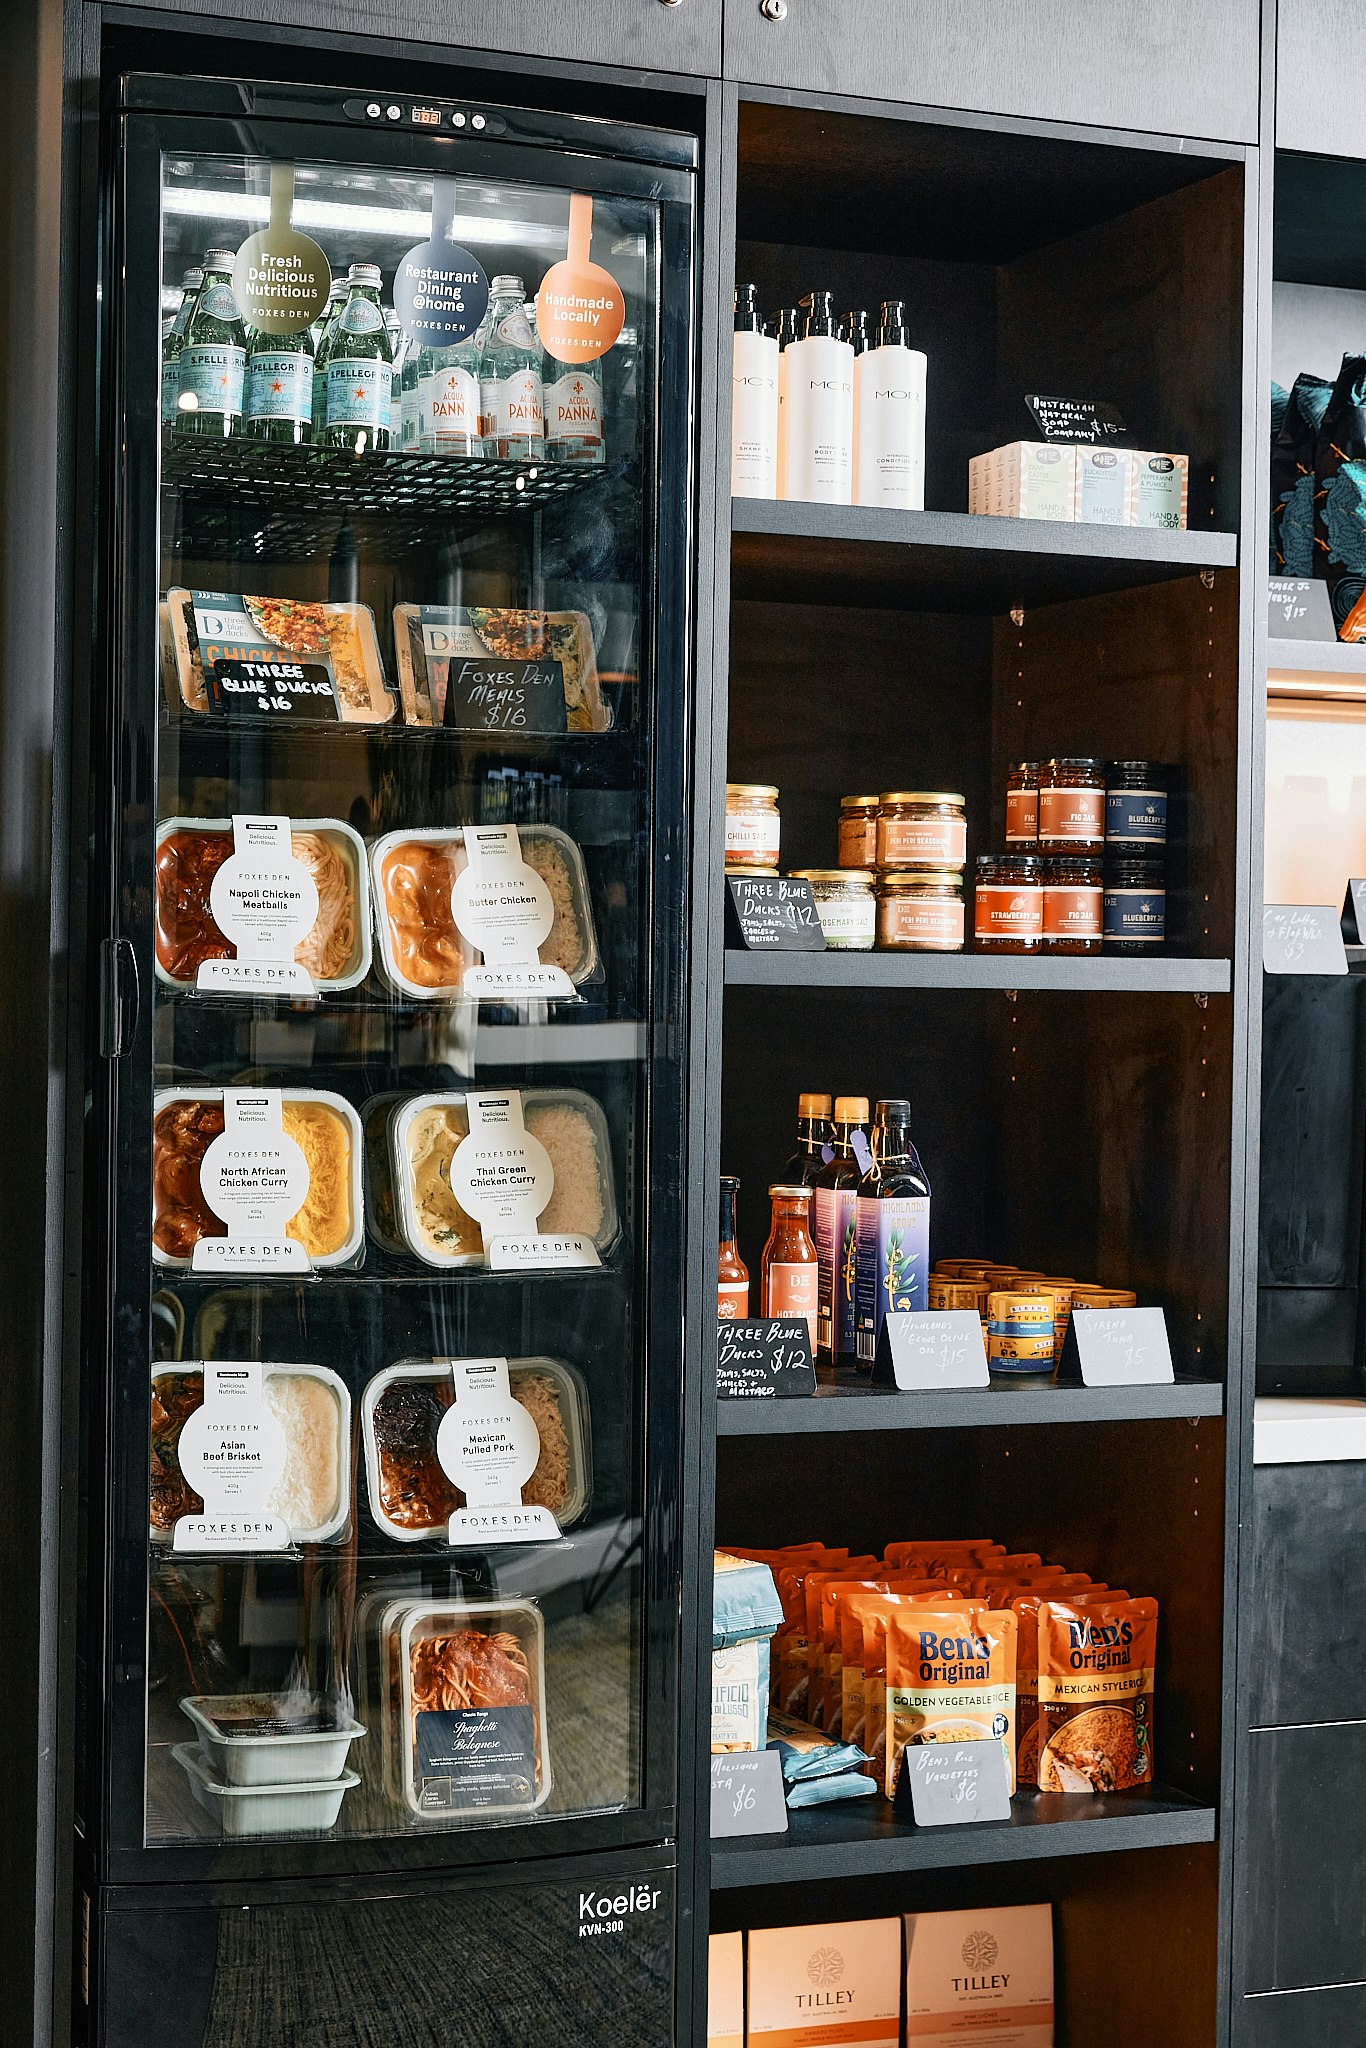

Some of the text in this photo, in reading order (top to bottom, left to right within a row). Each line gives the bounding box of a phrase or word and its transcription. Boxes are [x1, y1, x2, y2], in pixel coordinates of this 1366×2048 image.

[261, 253, 302, 268] Fresh
[248, 267, 315, 283] Delicious
[405, 264, 478, 284] Restaurant
[245, 282, 318, 298] Nutritious
[418, 280, 462, 300] Dining
[412, 295, 465, 312] @home
[545, 292, 614, 310] Handmade
[252, 308, 285, 318] FOXES
[554, 307, 600, 327] Locally
[410, 320, 466, 332] FOXES DEN
[550, 337, 602, 348] FOXES DEN
[444, 392, 464, 400] ACQUA
[569, 396, 590, 406] ACQUA
[1033, 396, 1095, 412] AUSTRALIAN
[558, 406, 597, 422] PANNA
[1039, 410, 1085, 420] NATURAL
[1042, 418, 1069, 427] SOAP
[1045, 426, 1094, 442] COMPANY
[1140, 474, 1173, 482] PEPPERMINT
[1038, 503, 1060, 511] HAND
[1093, 506, 1117, 516] HAND
[1046, 511, 1066, 520] BODY
[1102, 515, 1122, 524] BODY
[1150, 512, 1172, 520] HAND
[1158, 519, 1179, 528] BODY
[1283, 604, 1307, 621] $15
[225, 616, 246, 625] three
[226, 628, 248, 638] ducks
[451, 631, 472, 639] three
[451, 644, 474, 652] ducks
[454, 638, 470, 646] blue
[241, 664, 304, 678] THREE
[458, 662, 554, 684] FOXES DEN
[222, 678, 334, 696] BLUE DUCKS
[467, 688, 526, 706] MEALS
[258, 696, 292, 711] $16
[485, 704, 526, 728] $16
[1129, 815, 1160, 823] BLUEBERRY
[727, 832, 750, 840] CHILLI
[476, 881, 504, 889] FOXES
[732, 880, 808, 901] THREE BLUE
[230, 889, 300, 899] Napoli Chicken
[243, 900, 288, 910] Meatballs
[469, 895, 537, 907] Butter Chicken
[743, 899, 780, 916] DUCKS
[1079, 912, 1093, 920] JAM
[1123, 914, 1156, 922] BLUEBERRY
[212, 966, 296, 978] FOXES DEN
[476, 974, 556, 982] FOXES DEN
[475, 1151, 503, 1159] FOXES
[221, 1167, 286, 1176] North African
[476, 1166, 526, 1176] Thai Green
[219, 1178, 288, 1188] Chicken Curry
[470, 1176, 536, 1187] Chicken Curry
[883, 1200, 926, 1214] HIGHLANDS
[892, 1217, 916, 1228] GROVE
[208, 1246, 292, 1254] FOXES DEN
[502, 1242, 582, 1253] FOXES DEN
[777, 1309, 817, 1318] HOT SAUCE
[902, 1316, 952, 1337] HIGHLANDS
[1084, 1314, 1126, 1333] SIRENA
[717, 1322, 803, 1344] THREE BLUE
[908, 1333, 970, 1344] GROVE OLIVE
[1102, 1333, 1133, 1343] TUNA
[919, 1346, 935, 1355] OIL
[720, 1345, 809, 1374] DUCKS $12
[936, 1346, 968, 1373] $15
[1125, 1348, 1147, 1368] $5
[462, 1418, 490, 1426] FOXES
[469, 1434, 506, 1444] Mexican
[220, 1441, 245, 1450] Asian
[463, 1443, 514, 1455] Pulled Pork
[203, 1452, 261, 1461] Beef Brisket
[461, 1515, 542, 1526] FOXES DEN
[188, 1524, 273, 1533] FOXES DEN
[1068, 1618, 1132, 1650] Ben's
[919, 1630, 991, 1660] Ben's
[1070, 1646, 1130, 1670] Original
[919, 1661, 990, 1684] Original
[1055, 1678, 1144, 1694] MEXICAN STYLE RICE
[894, 1696, 936, 1706] GOLDEN
[939, 1695, 992, 1706] VEGETABLE
[715, 1704, 748, 1717] DI LUSSO
[453, 1719, 498, 1738] Spaghetti
[451, 1737, 500, 1754] Bolognese
[955, 1751, 974, 1763] RICE
[926, 1769, 978, 1785] VARIETIES
[955, 1781, 977, 1804] $6
[733, 1784, 756, 1817] $6
[579, 1884, 662, 1920] Koelër
[578, 1920, 624, 1937] KVN-300
[951, 1974, 1010, 1991] TILLEY
[795, 1990, 856, 2008] TILLEY
